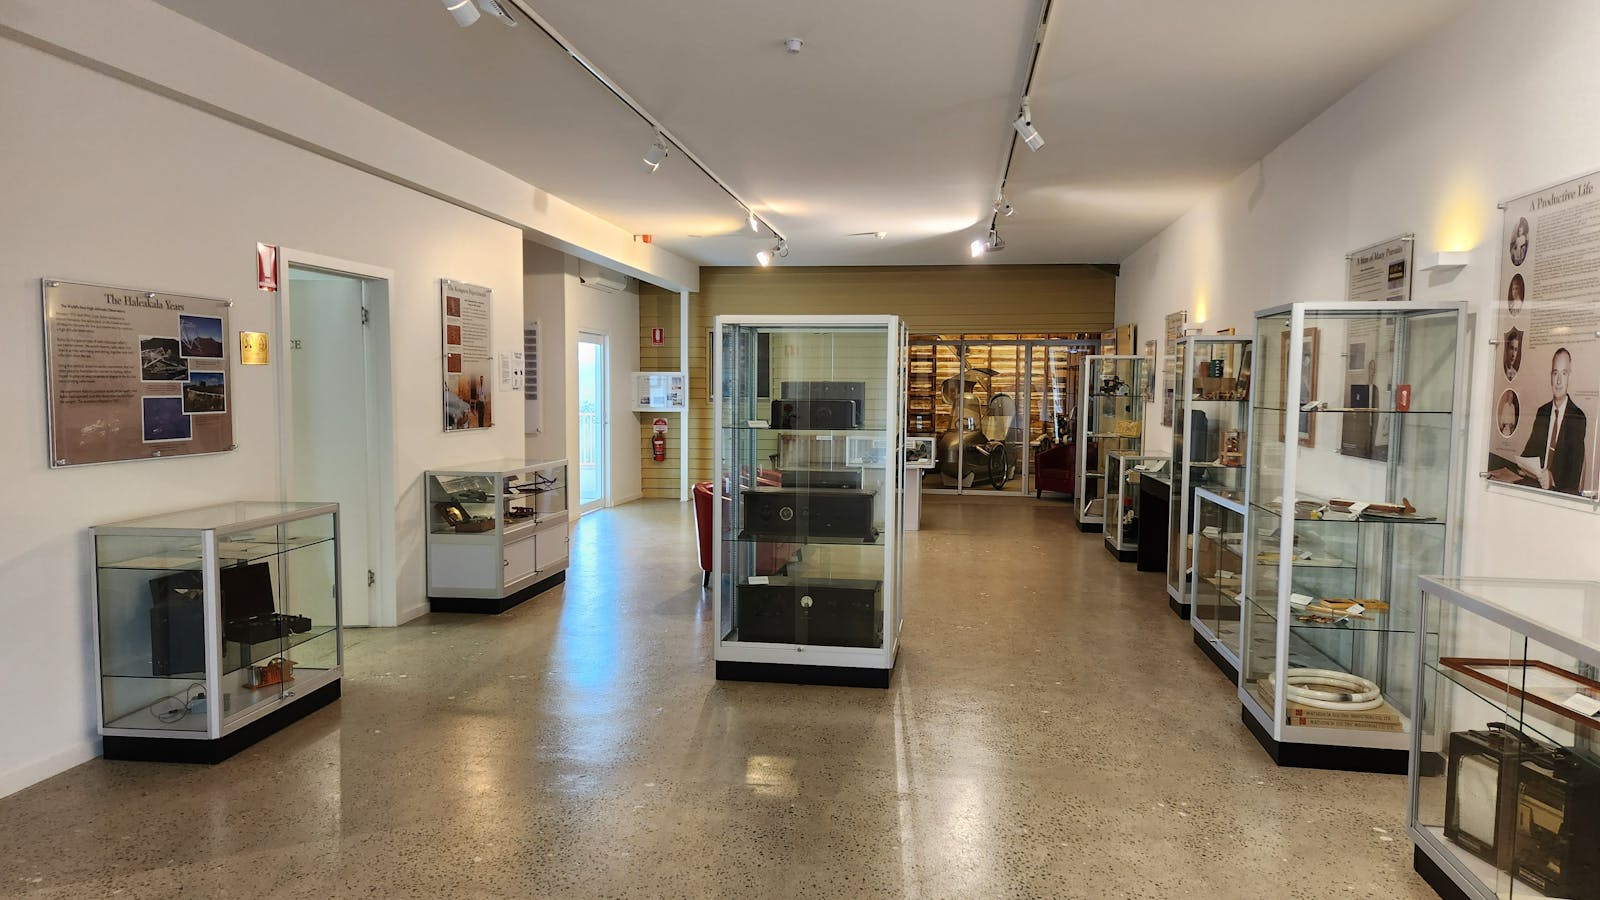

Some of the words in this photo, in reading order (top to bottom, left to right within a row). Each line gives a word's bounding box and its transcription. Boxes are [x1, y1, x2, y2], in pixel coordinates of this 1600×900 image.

[1537, 190, 1575, 209] Productive
[1578, 182, 1593, 197] Life
[104, 293, 121, 305] The
[124, 296, 163, 310] Haleakala
[165, 300, 185, 311] Years
